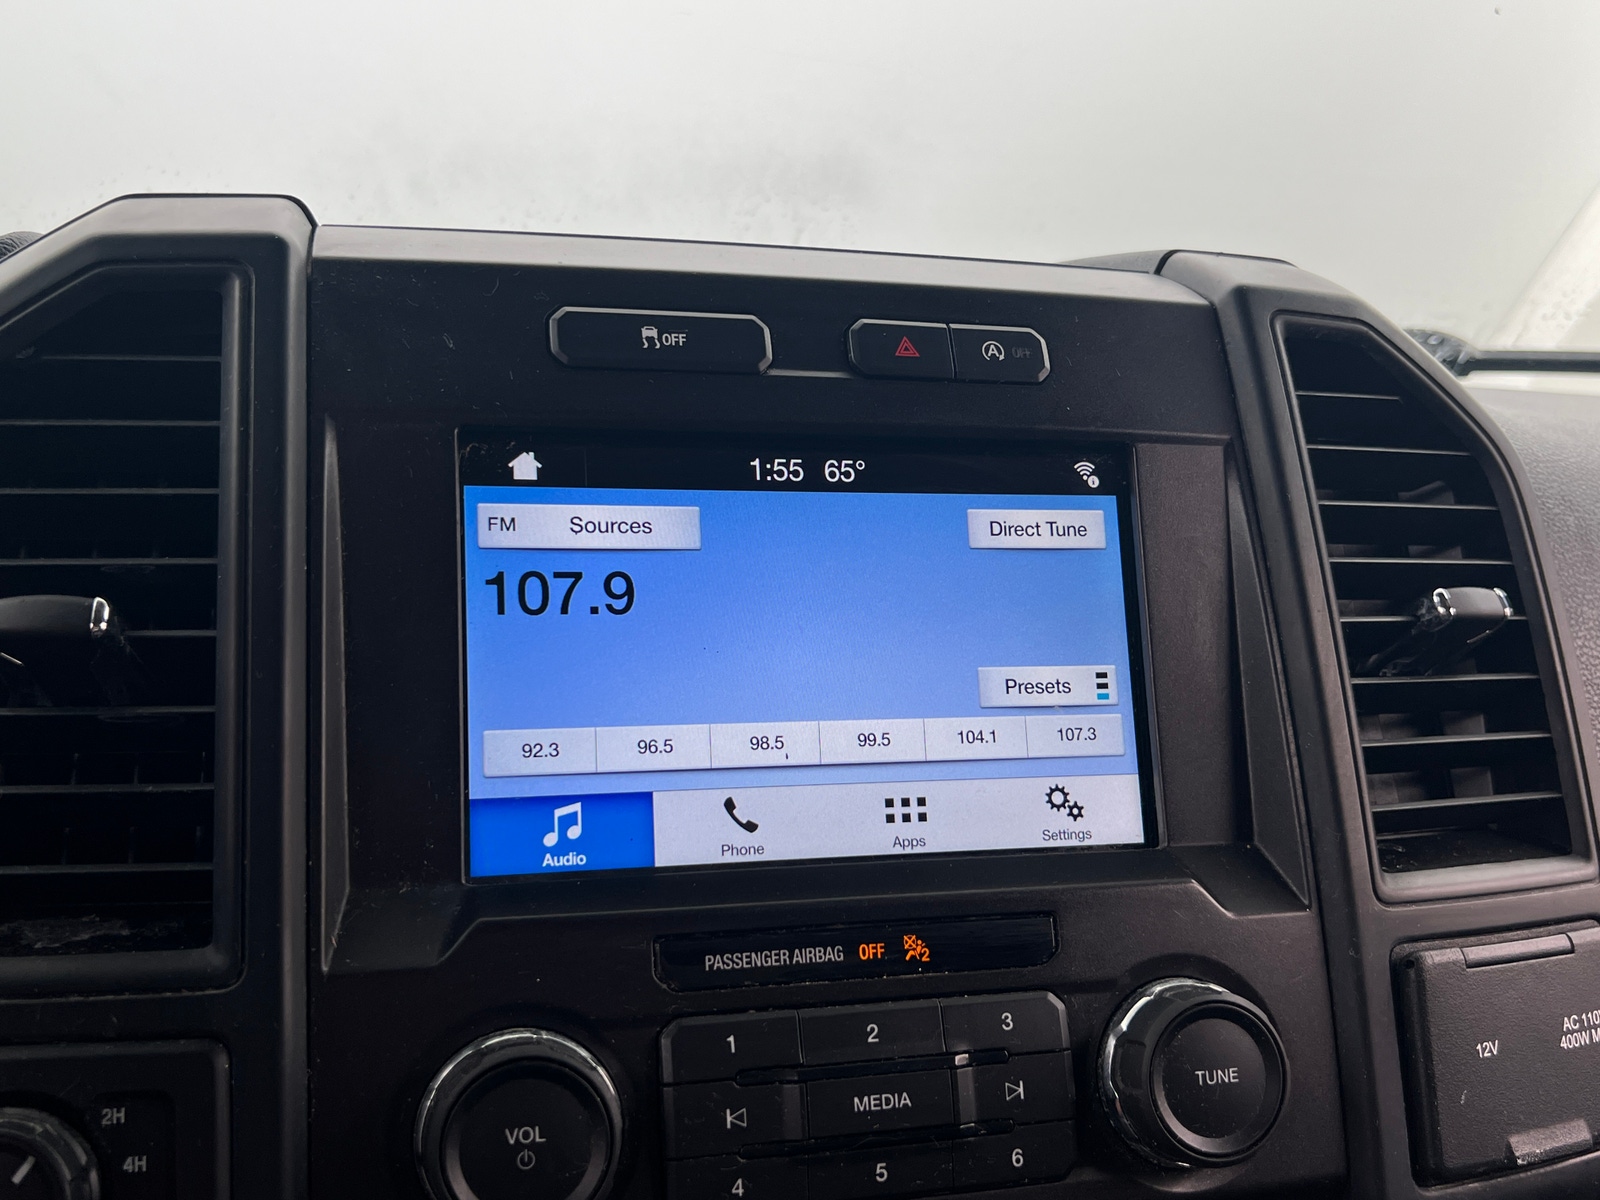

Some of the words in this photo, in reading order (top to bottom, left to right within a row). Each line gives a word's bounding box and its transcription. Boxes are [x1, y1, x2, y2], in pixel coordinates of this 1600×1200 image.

[662, 332, 687, 348] OFF
[750, 458, 804, 483] 1:55
[823, 458, 867, 483] 65°
[487, 517, 516, 532] FM
[569, 515, 653, 535] Sources
[989, 520, 1041, 538] Direct
[1045, 521, 1088, 538] Tune
[484, 570, 635, 616] 107.9
[1004, 676, 1072, 697] Presets
[749, 735, 785, 751] 98.5
[856, 732, 892, 747] 99.5
[956, 728, 997, 744] 104.1
[1056, 726, 1097, 742] 107.3
[521, 742, 560, 759] 92.3
[636, 738, 674, 754] 96.5
[892, 834, 927, 850] Apps
[1041, 826, 1092, 843] Settings
[720, 841, 765, 856] Phone
[542, 851, 587, 868] Audio
[705, 949, 790, 971] PASSENGER
[792, 945, 844, 965] AIRBAG
[859, 943, 885, 960] OFF
[1001, 1012, 1013, 1031] 3
[1563, 1014, 1579, 1031] AC
[1581, 1009, 1600, 1027] 110
[867, 1024, 879, 1043] 2
[1560, 1030, 1590, 1049] 400W
[726, 1035, 736, 1053] 1
[1475, 1040, 1498, 1058] 12V
[1195, 1067, 1239, 1086] TUNE
[853, 1091, 912, 1113] MEDIA
[102, 1107, 126, 1125] 2H
[505, 1126, 547, 1144] VOL
[123, 1155, 147, 1173] 4H
[1011, 1149, 1023, 1168] 6
[875, 1163, 888, 1182] 5
[731, 1178, 745, 1197] 4
